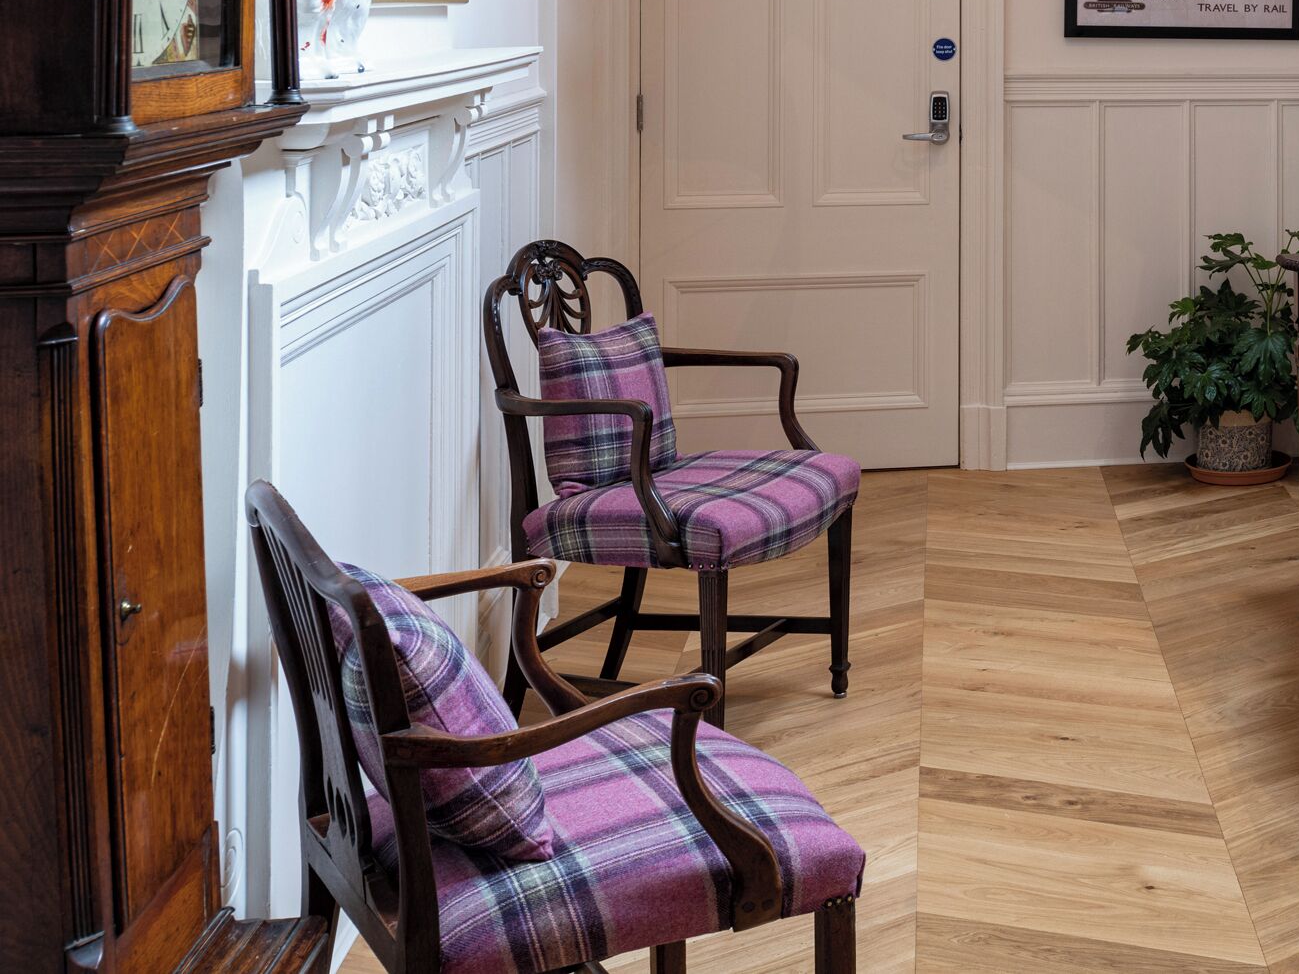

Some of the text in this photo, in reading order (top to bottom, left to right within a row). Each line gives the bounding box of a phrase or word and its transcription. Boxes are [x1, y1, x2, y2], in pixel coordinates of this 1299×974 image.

[1197, 3, 1288, 14] TRAVEL BY RAIL
